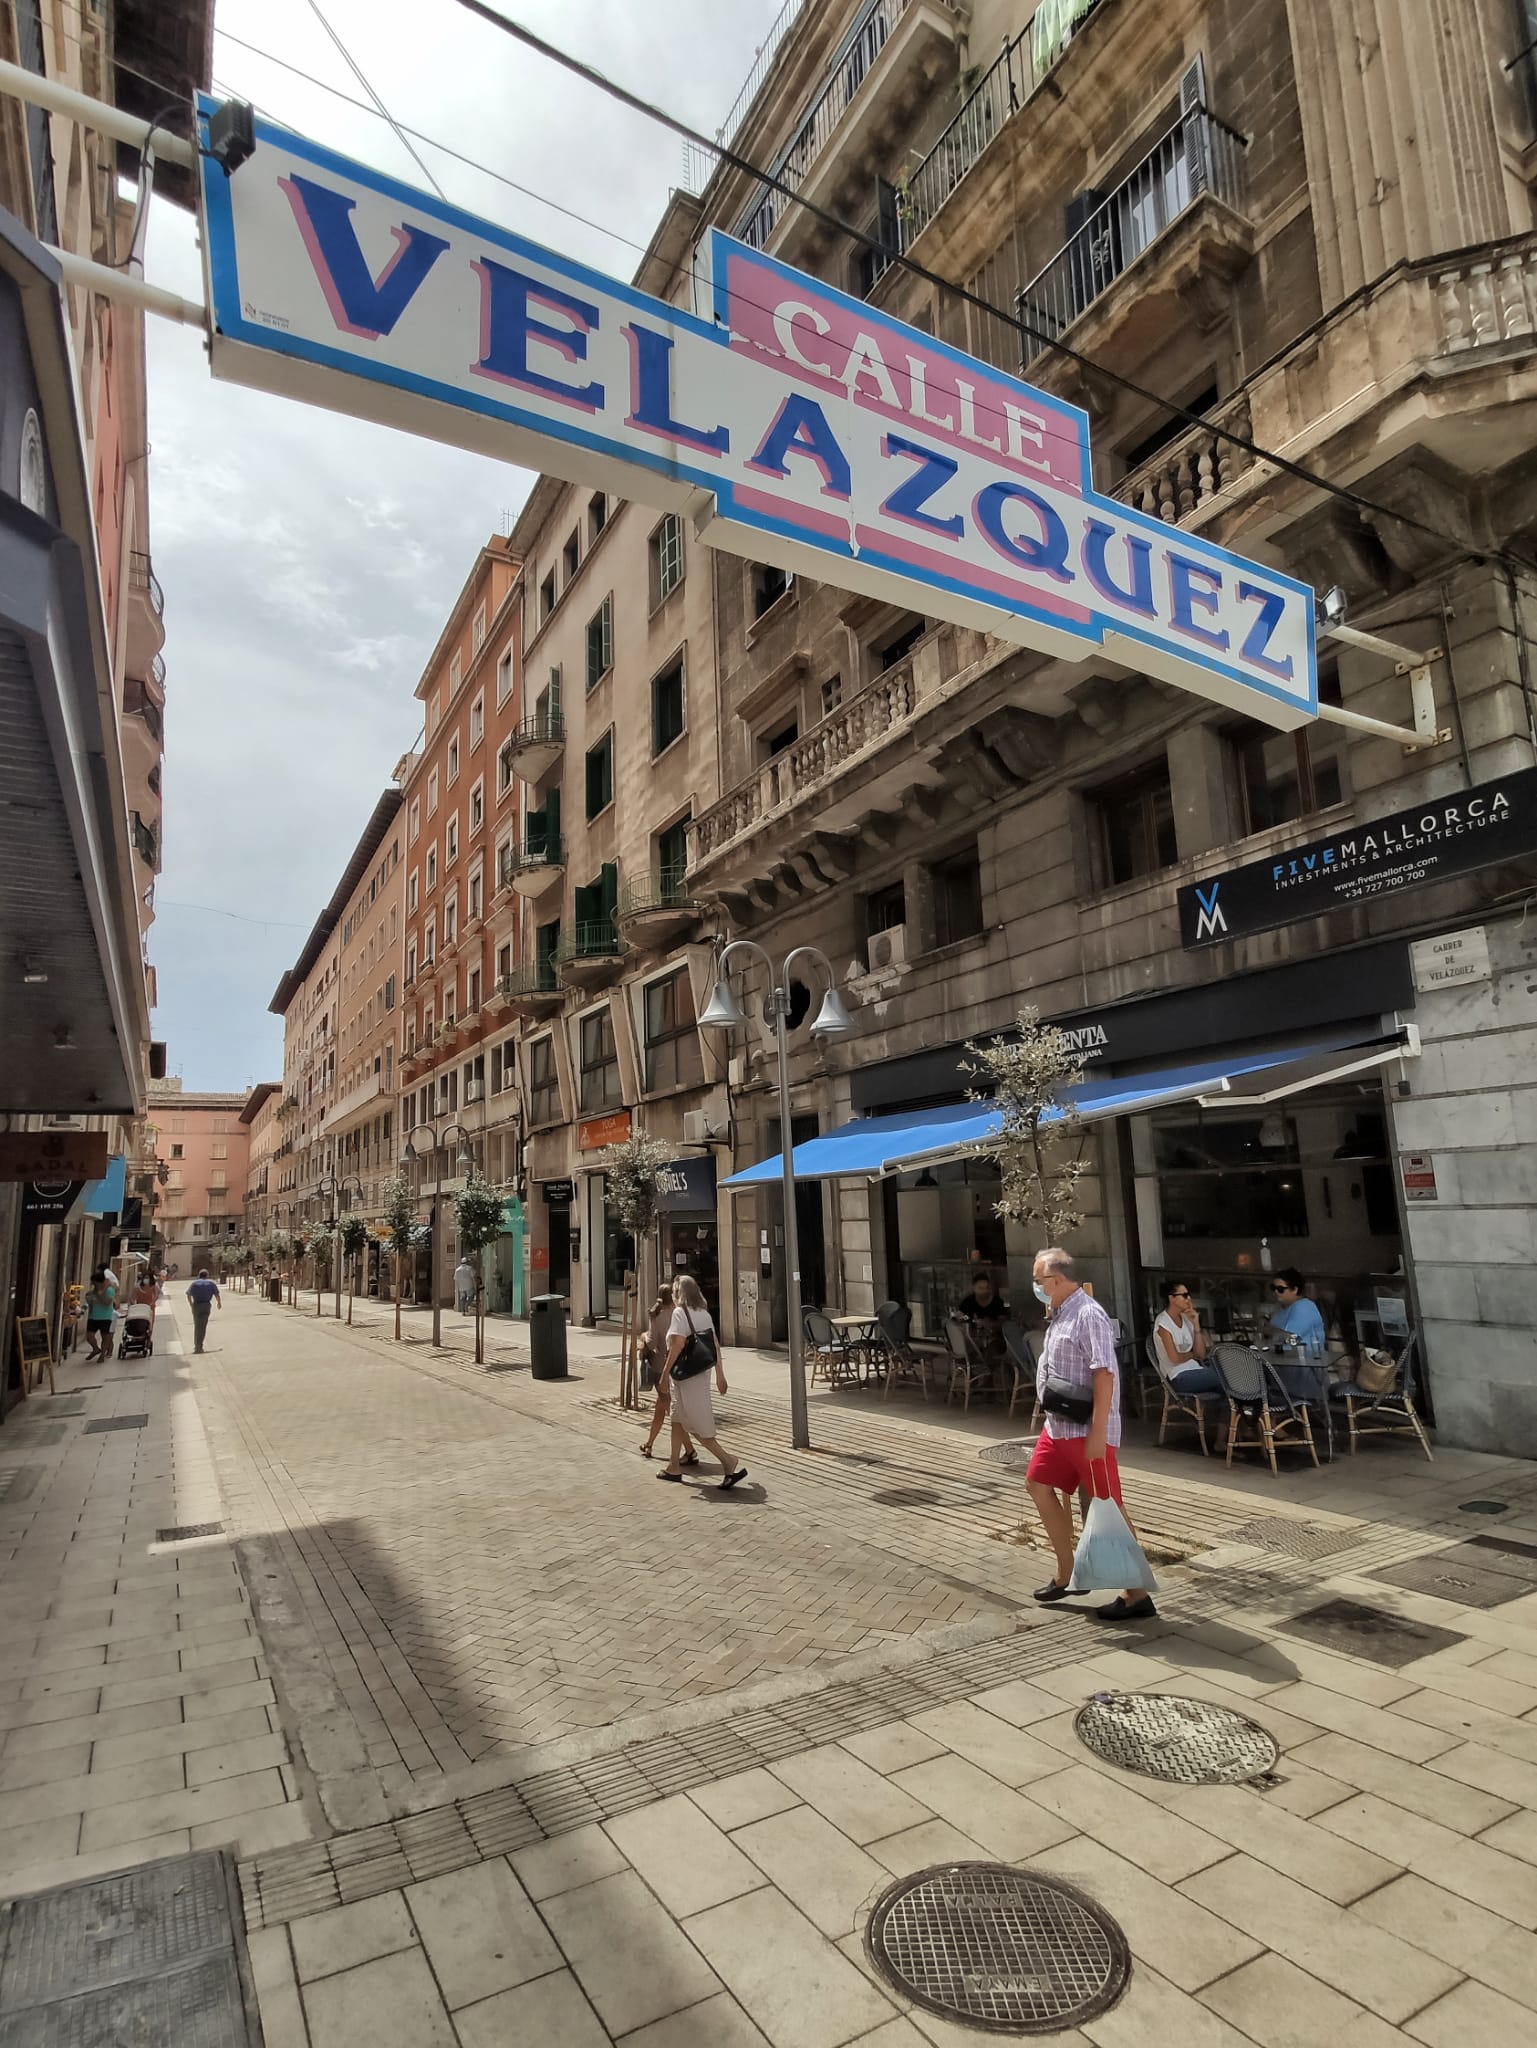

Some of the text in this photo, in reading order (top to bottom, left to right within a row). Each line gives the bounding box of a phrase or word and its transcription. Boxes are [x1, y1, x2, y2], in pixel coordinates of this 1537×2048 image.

[772, 300, 1051, 473] CALLE
[277, 172, 1297, 681] VELAZQUEZ
[1275, 809, 1510, 891] INVESTMENTS & ARCHITECTURE
[1333, 855, 1439, 892] www.fivemallorca.com
[1344, 869, 1426, 899] +34 727 700 700
[1433, 939, 1463, 953] CARRER
[1445, 955, 1455, 965] DE
[970, 1976, 1041, 1990] EMAYA
